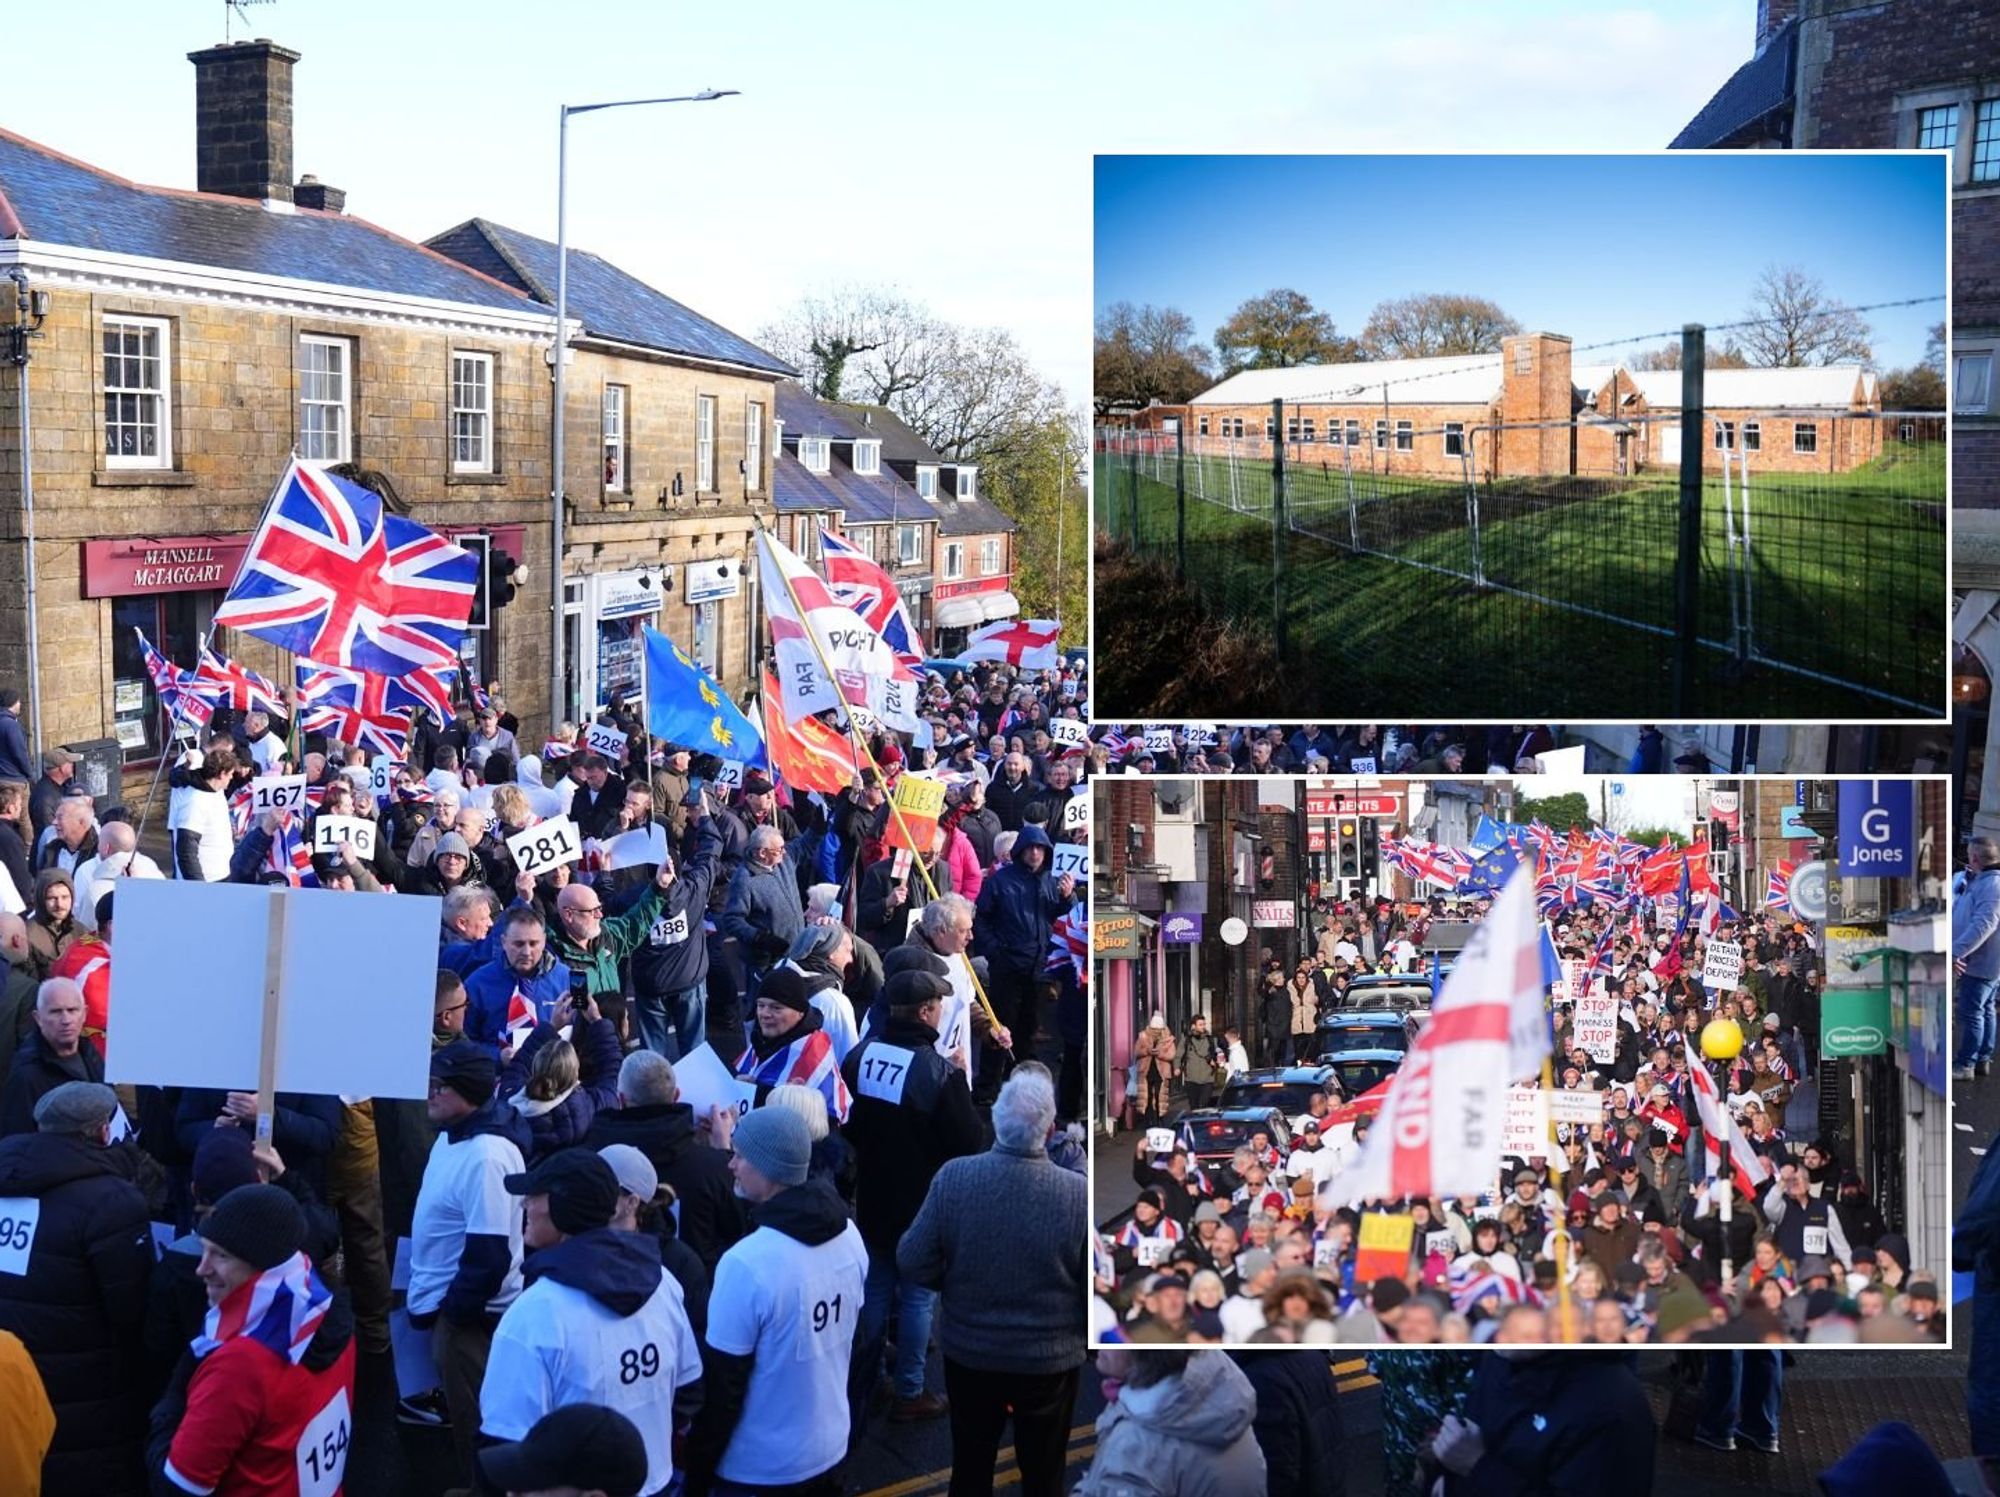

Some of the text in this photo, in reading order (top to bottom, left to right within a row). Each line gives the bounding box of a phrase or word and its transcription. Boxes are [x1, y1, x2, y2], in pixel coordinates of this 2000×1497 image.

[143, 547, 214, 565] MANSELL
[133, 564, 224, 586] McTAGGART
[590, 731, 621, 754] 228
[1146, 736, 1170, 749] 223
[257, 784, 303, 808] 167
[1861, 808, 1891, 843] G
[320, 825, 370, 850] 116
[518, 830, 573, 872] 281
[1848, 844, 1903, 867] Jones
[1253, 908, 1294, 921] NAILS
[653, 919, 685, 937] 188
[1708, 954, 1739, 968] PROCESS
[1709, 943, 1739, 956] DETAIN
[1582, 999, 1613, 1011] STOP
[1581, 1030, 1612, 1042] STOP
[864, 1057, 904, 1086] 177
[812, 1293, 842, 1333] 91
[619, 1342, 660, 1385] 89
[305, 1418, 349, 1483] 154
